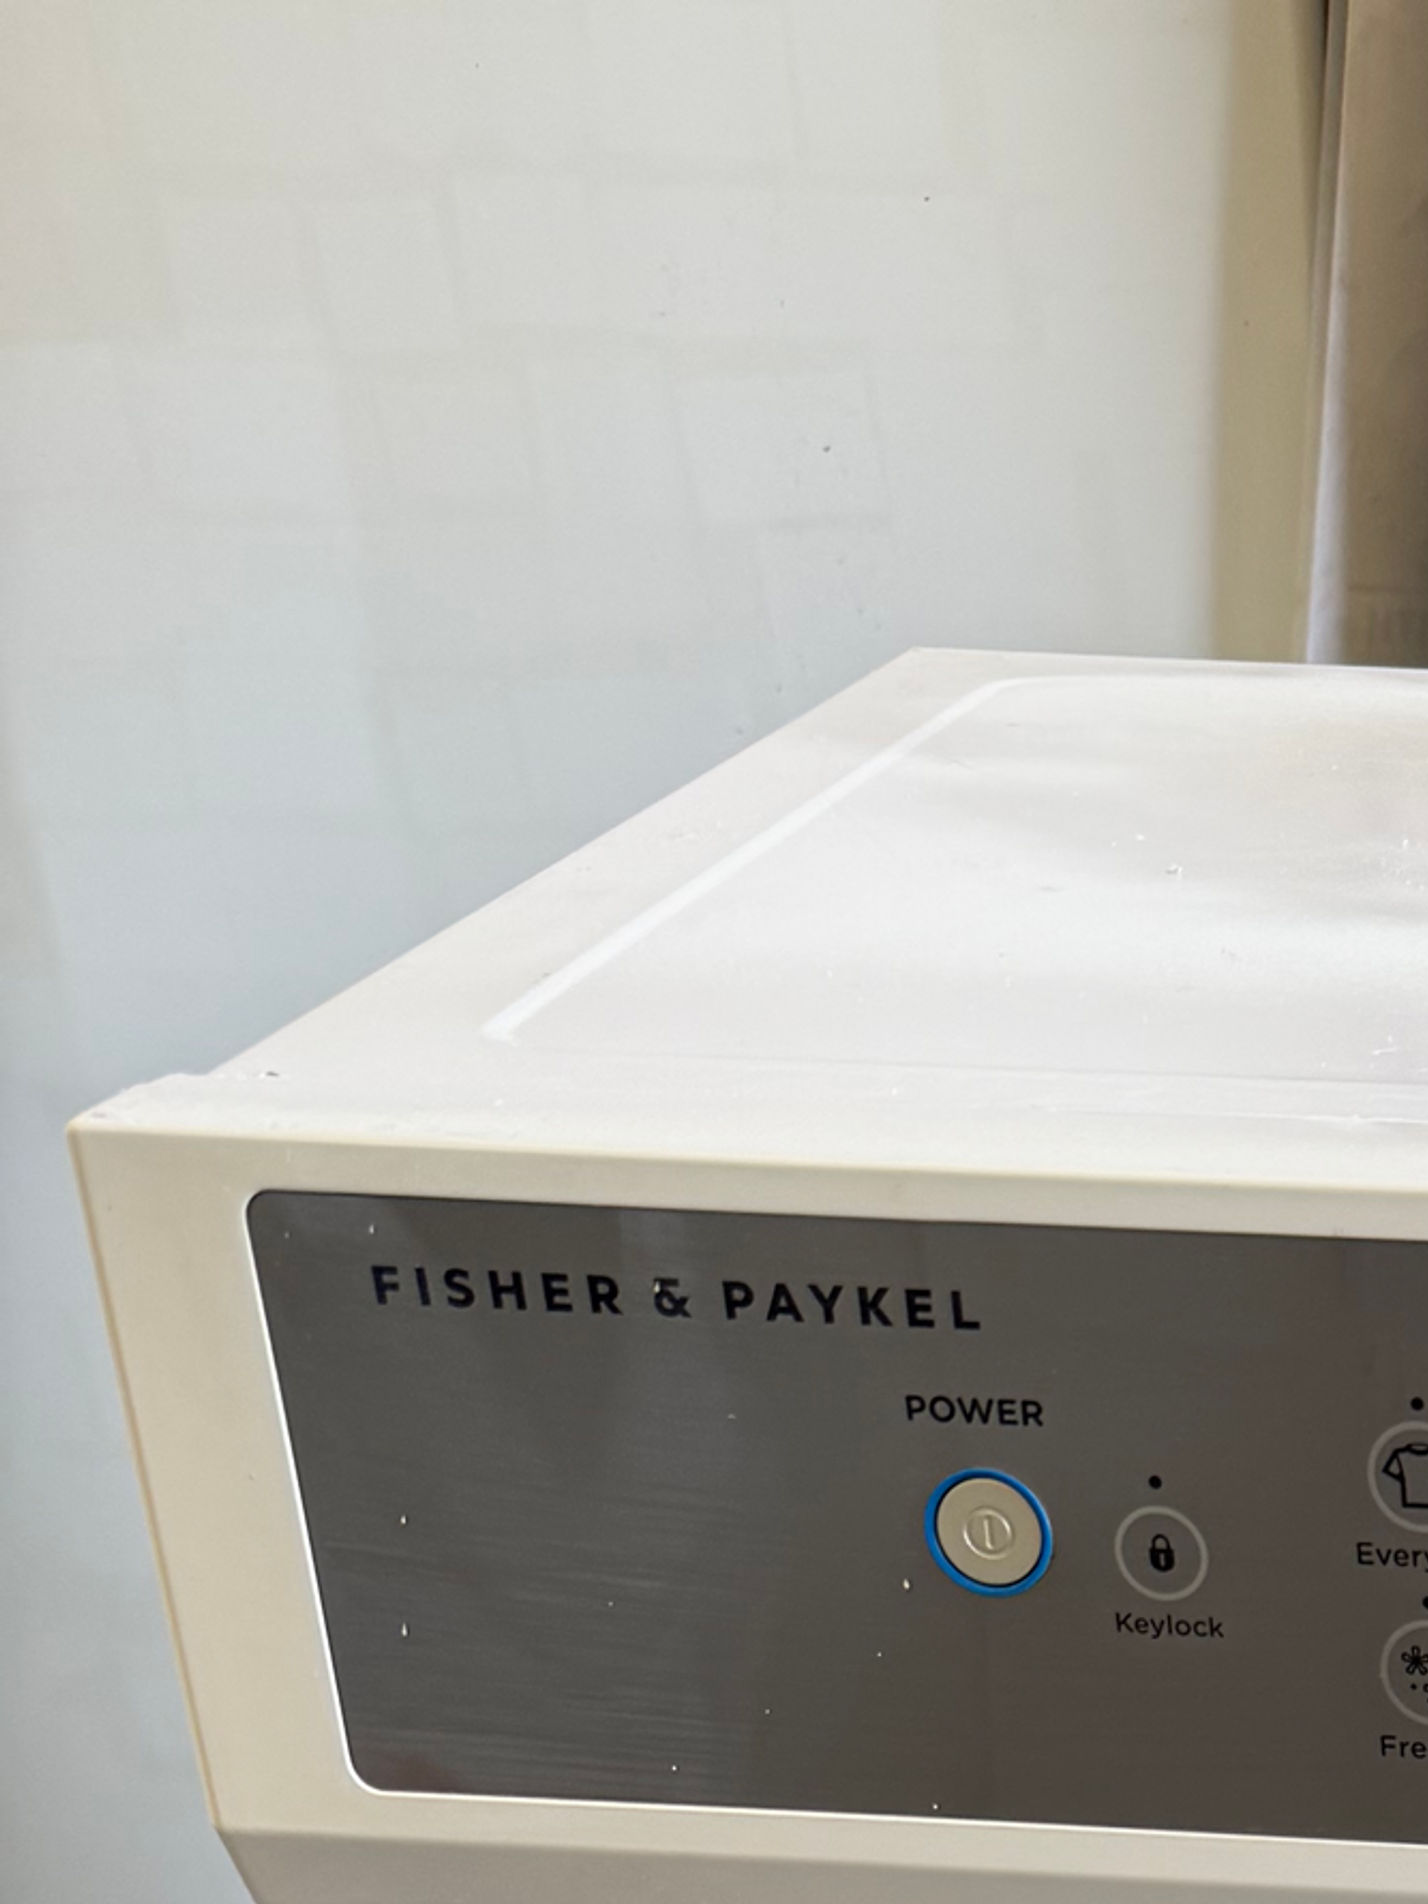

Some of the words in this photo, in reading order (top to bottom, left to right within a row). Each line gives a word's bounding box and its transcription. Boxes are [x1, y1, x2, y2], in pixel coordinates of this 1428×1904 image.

[371, 1264, 623, 1317] FISHER
[653, 1276, 692, 1319] &
[722, 1279, 982, 1331] PAYKEL
[904, 1394, 1045, 1428] POWER
[1115, 1611, 1225, 1640] Keylock
